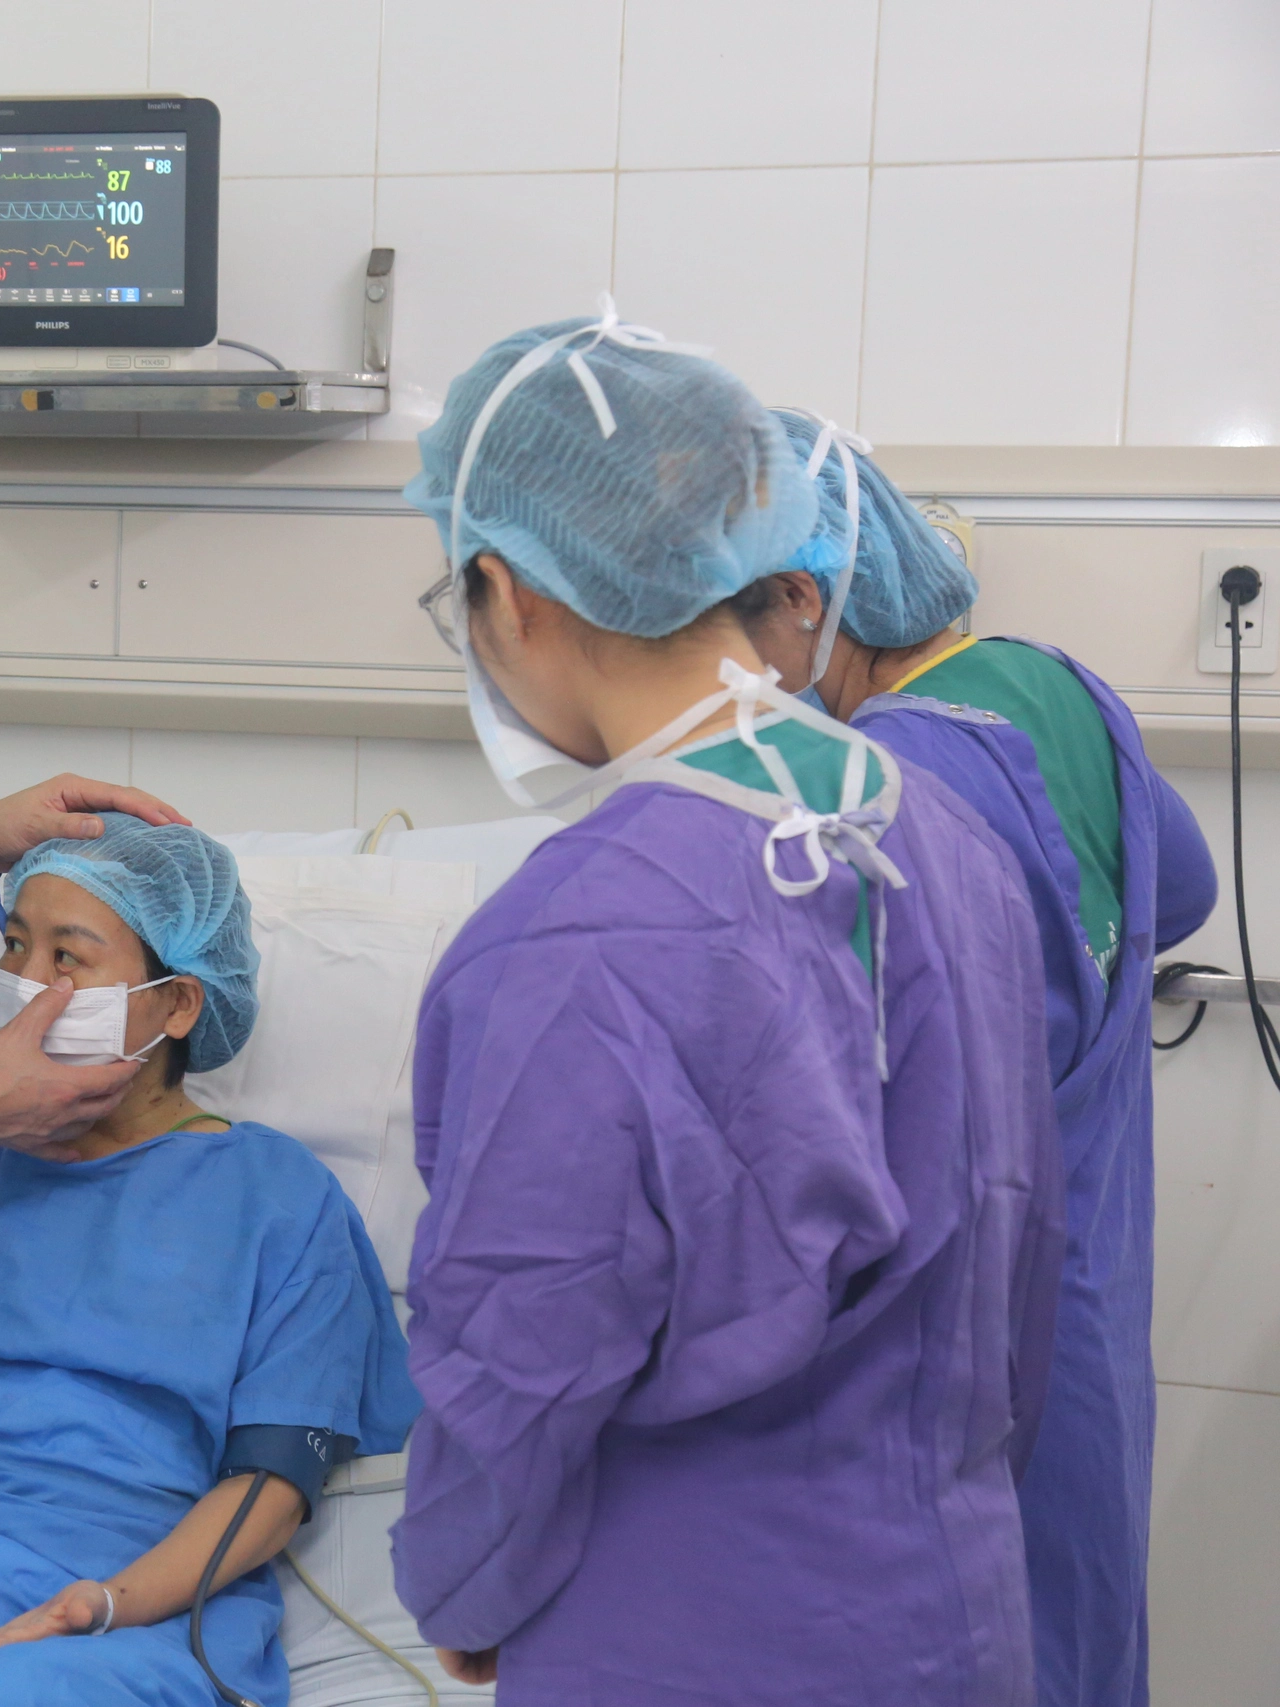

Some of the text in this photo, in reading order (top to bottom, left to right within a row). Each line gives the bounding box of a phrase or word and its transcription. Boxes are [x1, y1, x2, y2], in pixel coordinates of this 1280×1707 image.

[147, 102, 181, 110] IntelliVue
[155, 159, 172, 174] 88
[107, 170, 131, 191] 87
[107, 201, 143, 225] 100
[106, 235, 129, 259] 16
[35, 321, 70, 330] PHILIPS
